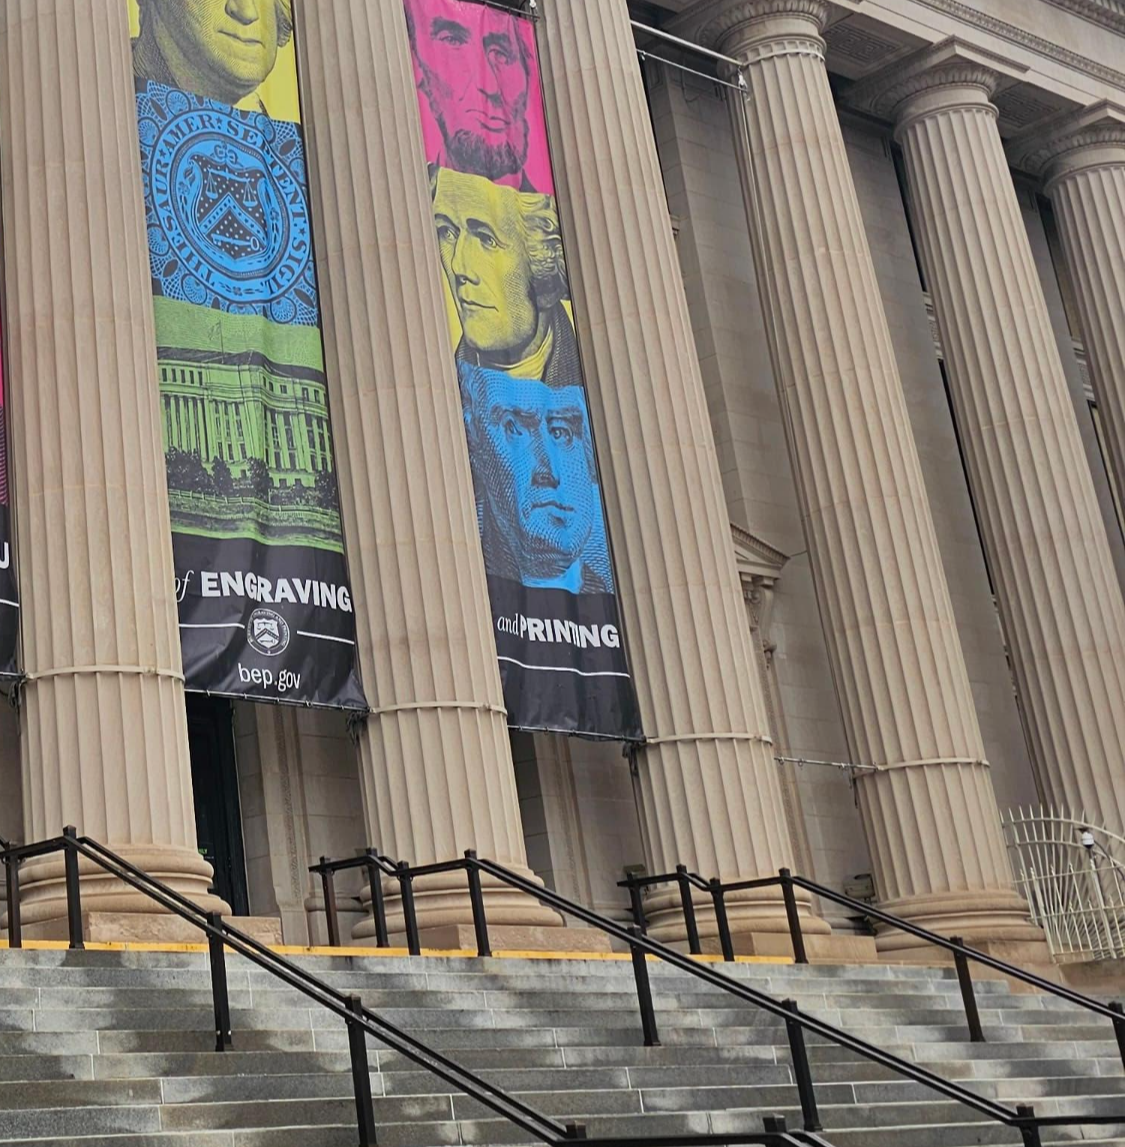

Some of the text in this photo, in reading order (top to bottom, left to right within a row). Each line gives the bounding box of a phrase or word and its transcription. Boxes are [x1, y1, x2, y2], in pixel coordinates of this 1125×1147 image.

[200, 570, 353, 613] ENGRAVING
[497, 613, 621, 649] and PRINTING
[237, 662, 301, 691] bep.gov
